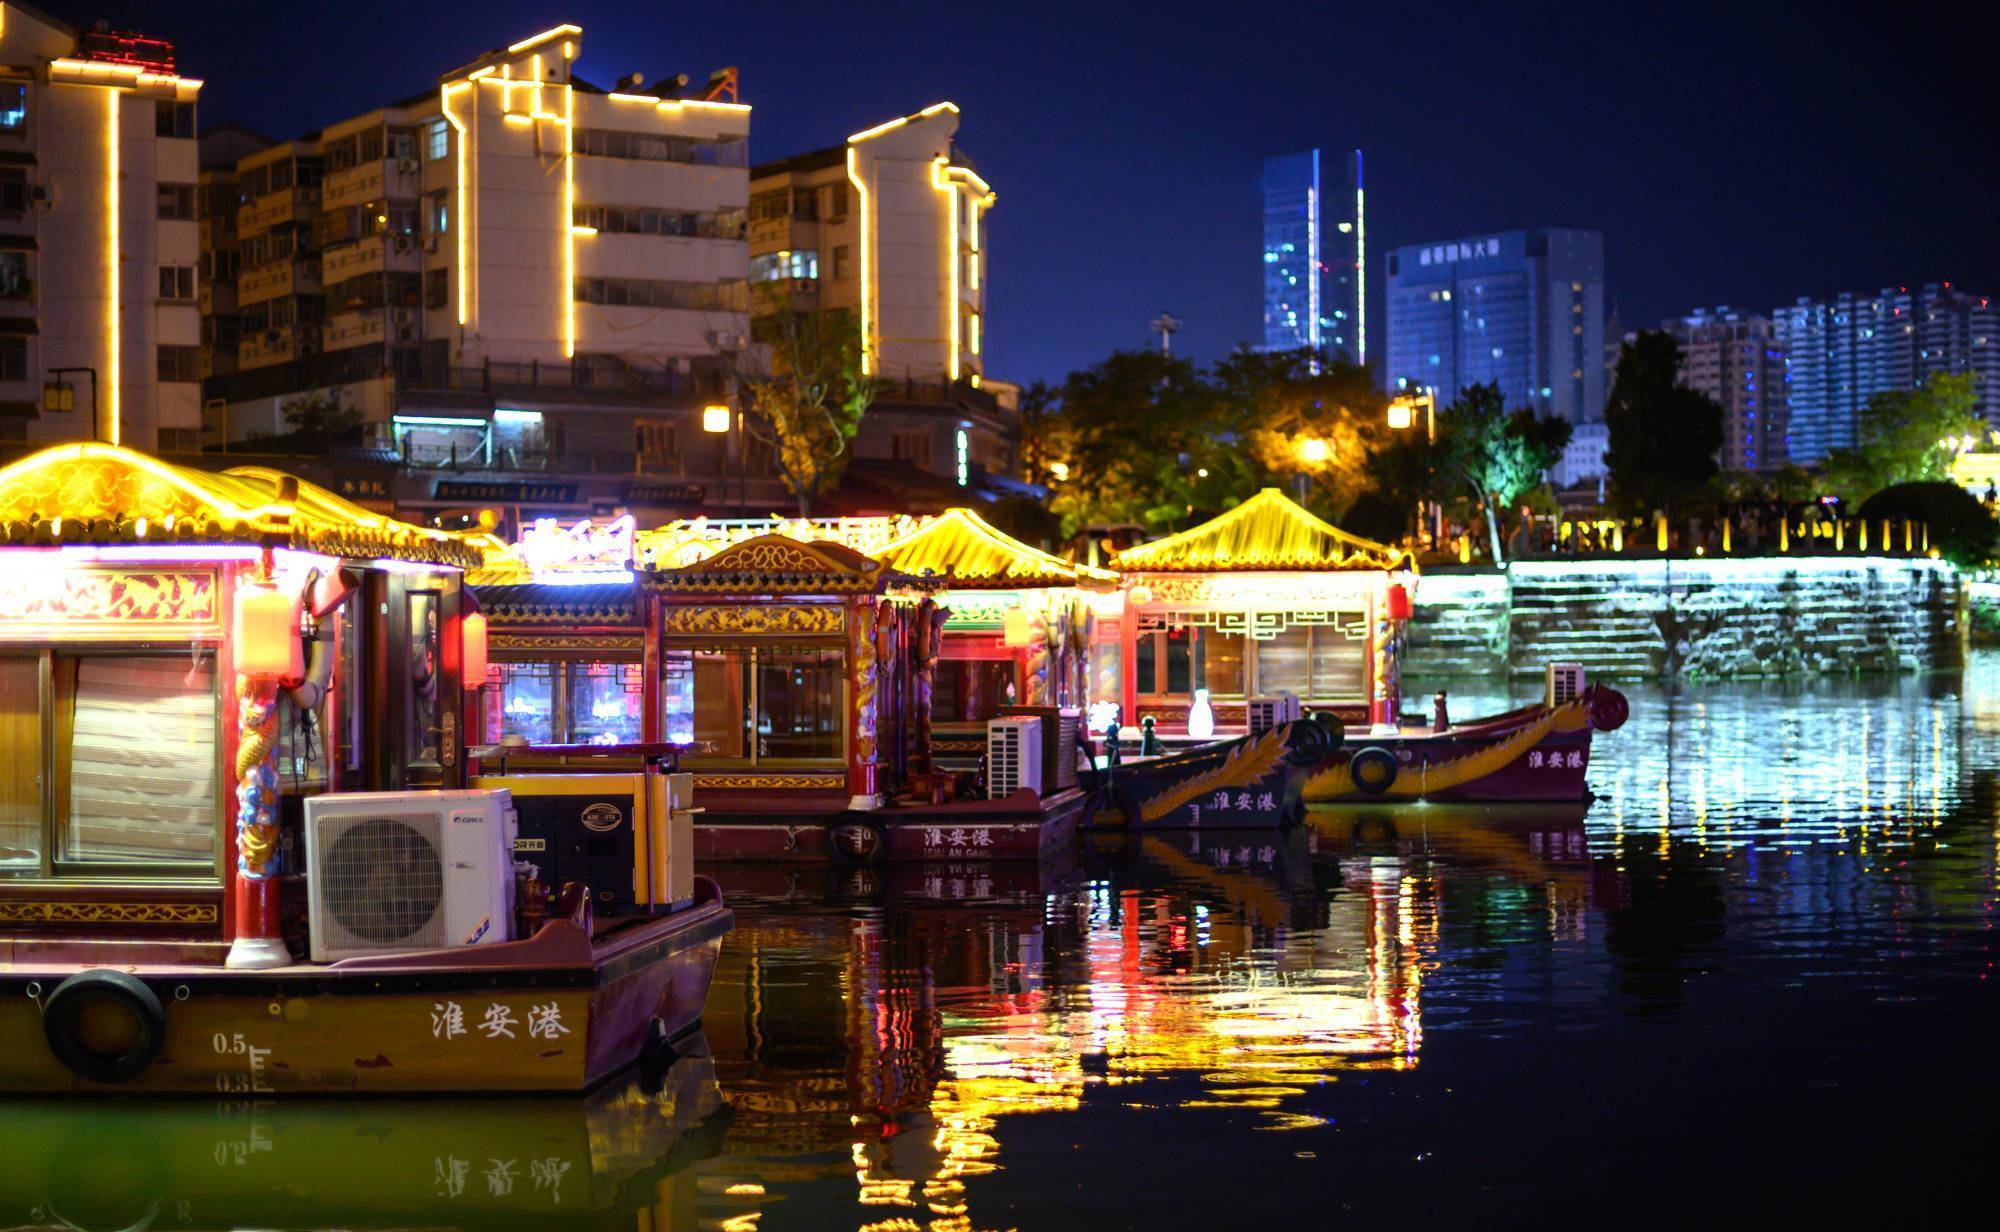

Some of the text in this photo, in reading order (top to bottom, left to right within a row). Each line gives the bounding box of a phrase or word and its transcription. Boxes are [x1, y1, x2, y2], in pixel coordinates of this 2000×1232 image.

[1528, 750, 1584, 769] 淮安港
[1213, 791, 1277, 811] 淮安港
[923, 828, 995, 847] 淮安港
[948, 848, 962, 857] AN
[430, 1001, 571, 1041] 淮安港
[212, 1032, 247, 1055] 0.5
